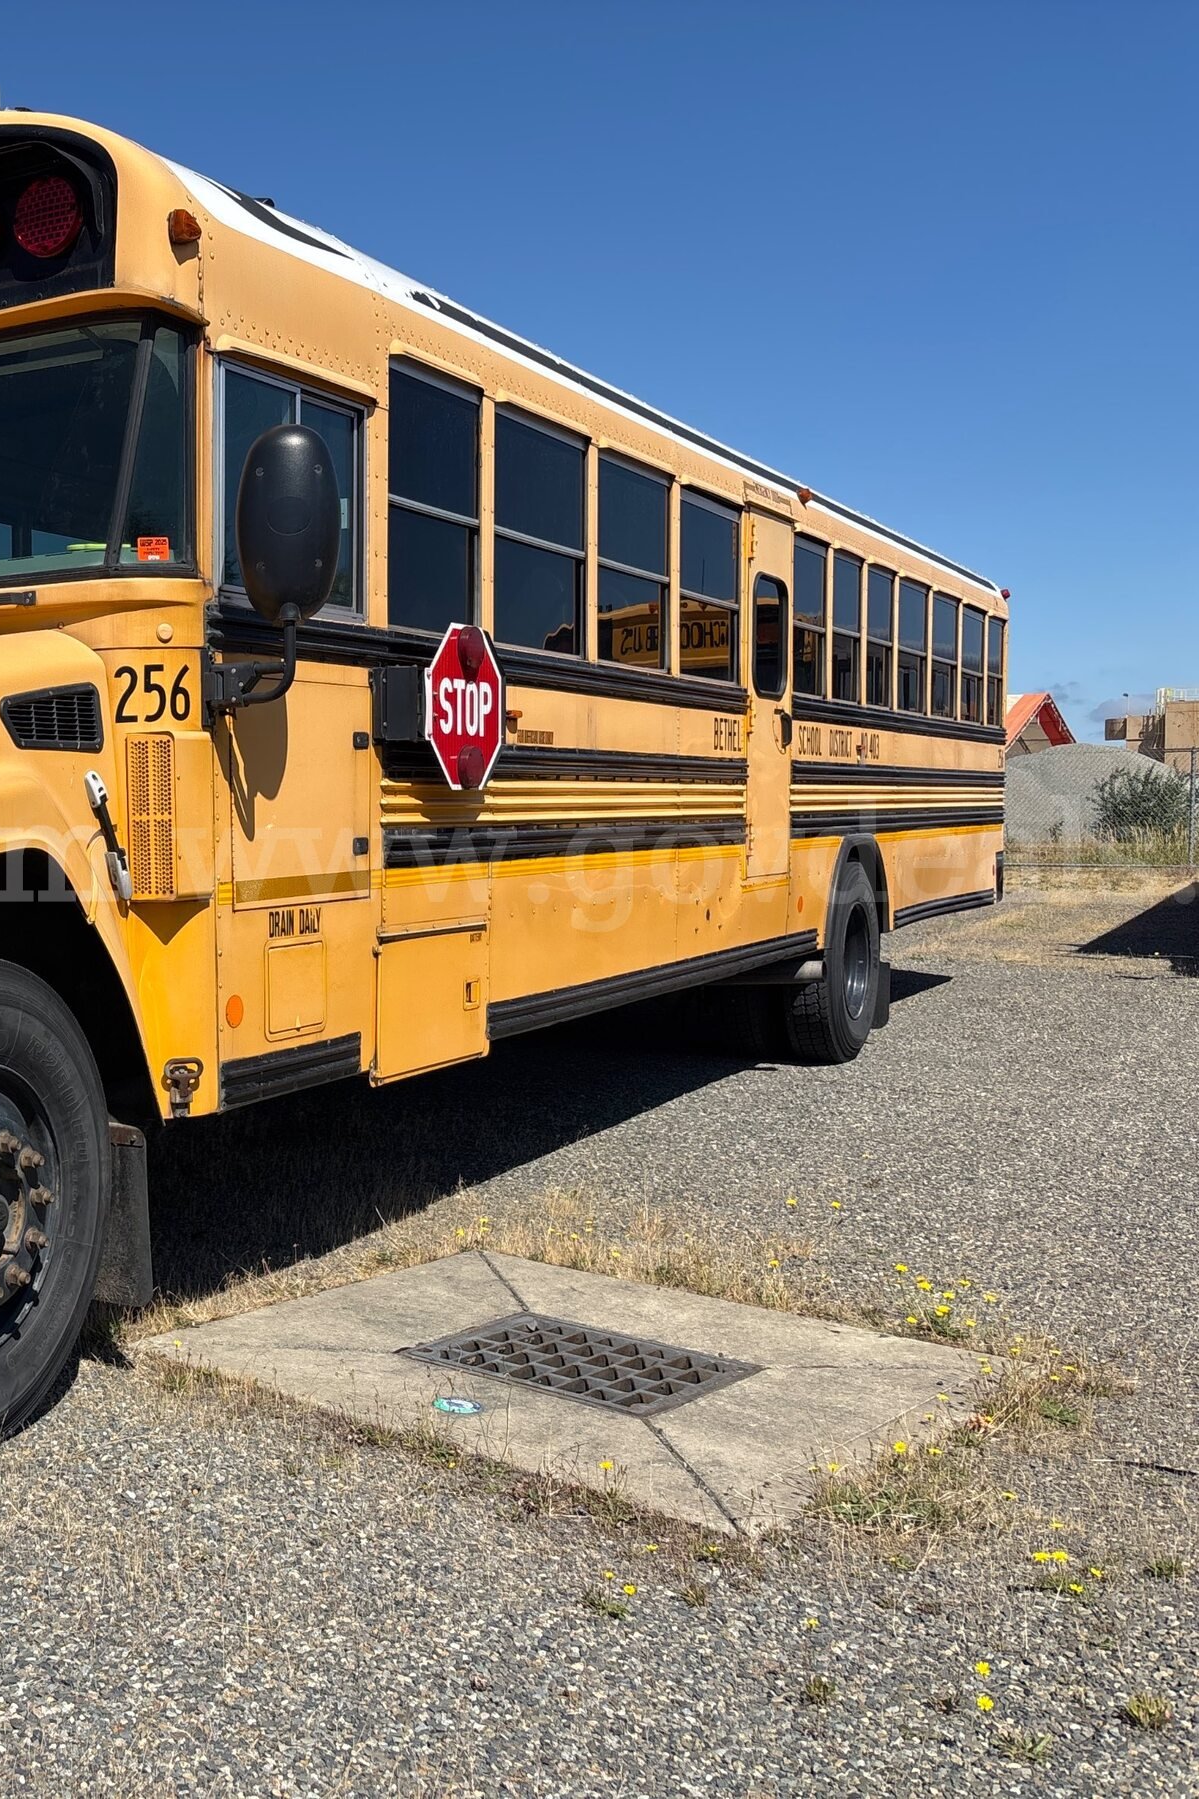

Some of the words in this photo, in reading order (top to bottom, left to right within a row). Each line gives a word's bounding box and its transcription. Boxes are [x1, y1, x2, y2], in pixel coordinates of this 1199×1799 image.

[113, 664, 191, 724] 256
[439, 677, 493, 738] STOP
[713, 717, 742, 752] BETHEL
[798, 725, 823, 757] SCHOOL
[829, 729, 853, 758] DISTRICT
[869, 733, 880, 760] 403
[268, 909, 295, 938] DRAIN
[299, 906, 322, 935] DAILY
